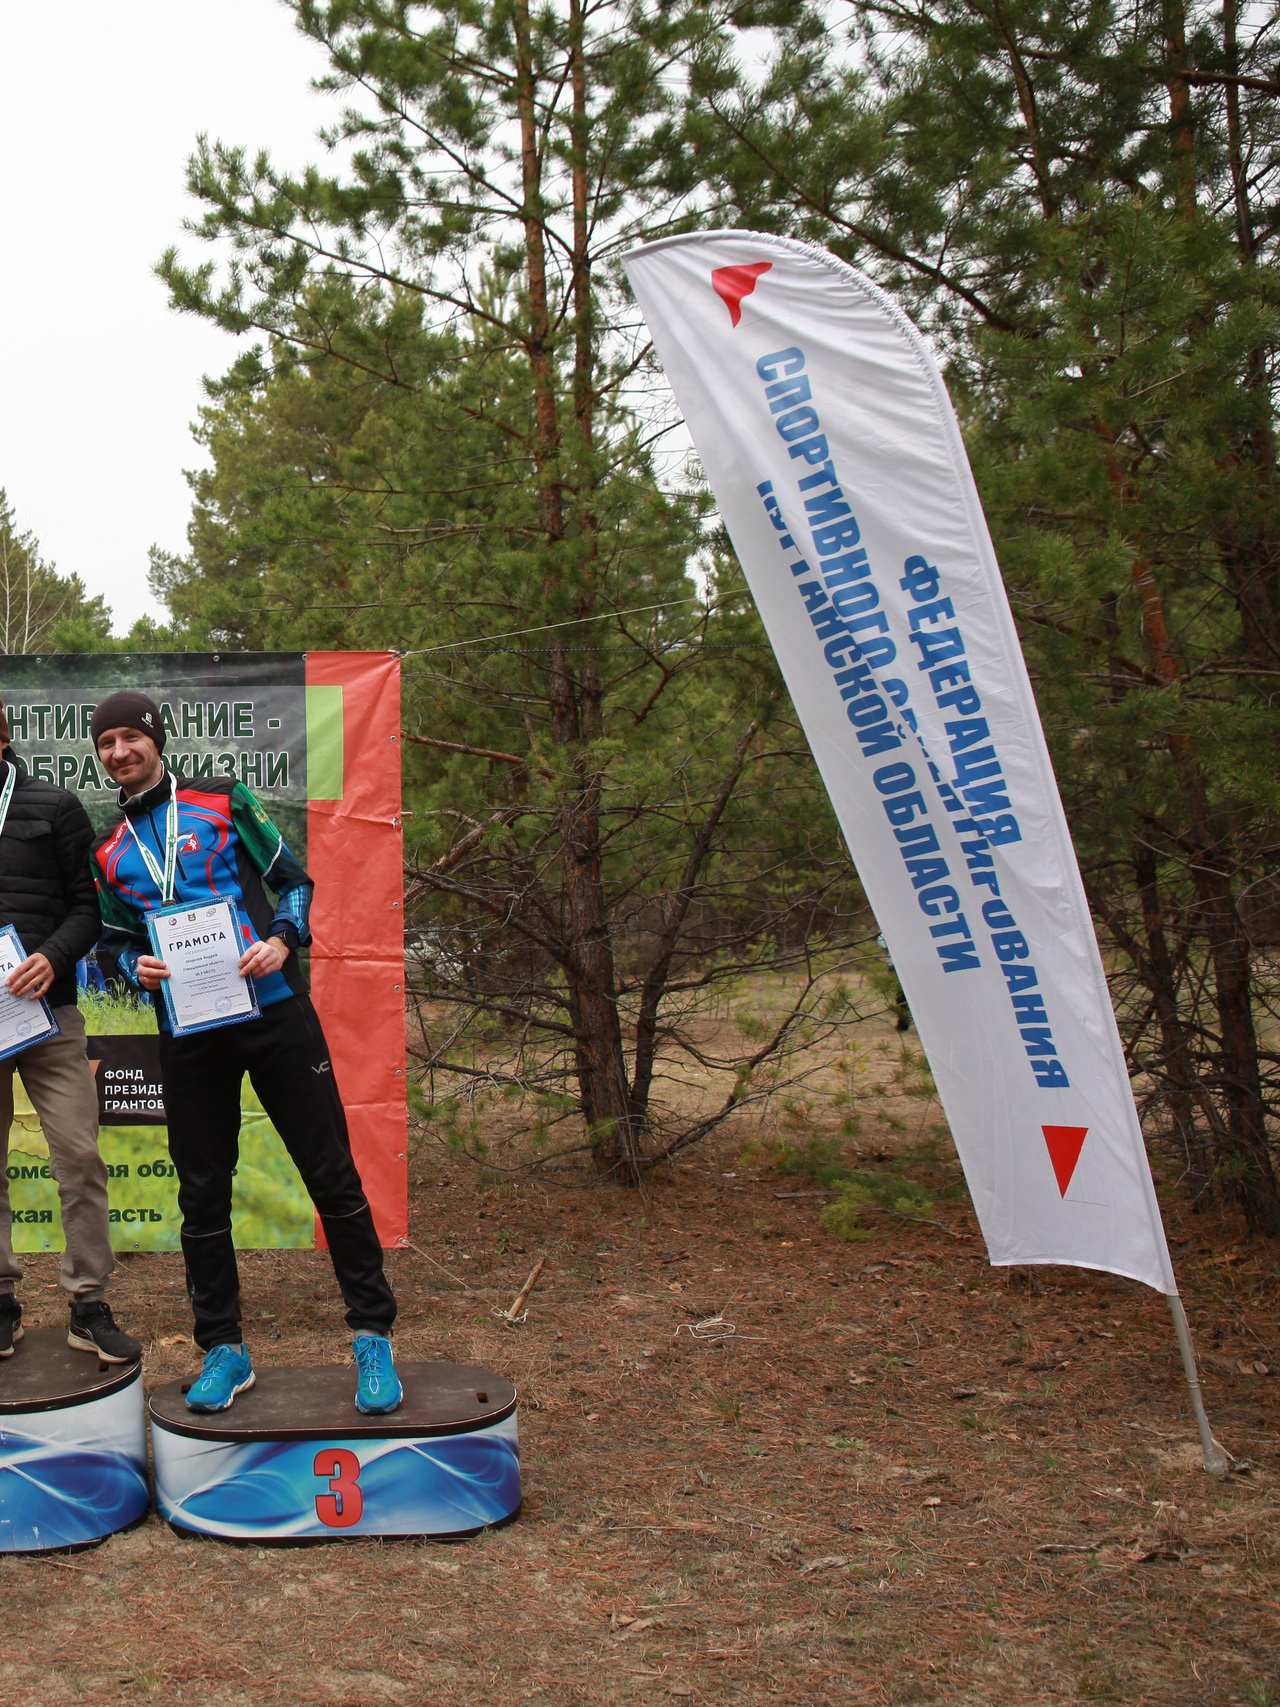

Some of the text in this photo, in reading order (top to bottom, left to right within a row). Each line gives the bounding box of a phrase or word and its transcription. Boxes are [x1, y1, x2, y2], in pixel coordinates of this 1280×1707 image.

[756, 346, 897, 670] СПОРТИВНОГО
[899, 555, 1022, 847] ФЕДЕРАЦИЯ
[873, 760, 982, 974] ОБЛАСТИ
[168, 931, 227, 952] ГРАМОТА
[104, 1069, 144, 1081] ФОНД
[104, 1084, 163, 1096] ПРЕЗИДЕ
[104, 1099, 165, 1110] ГРАНТОВ
[313, 1449, 364, 1527] 3
